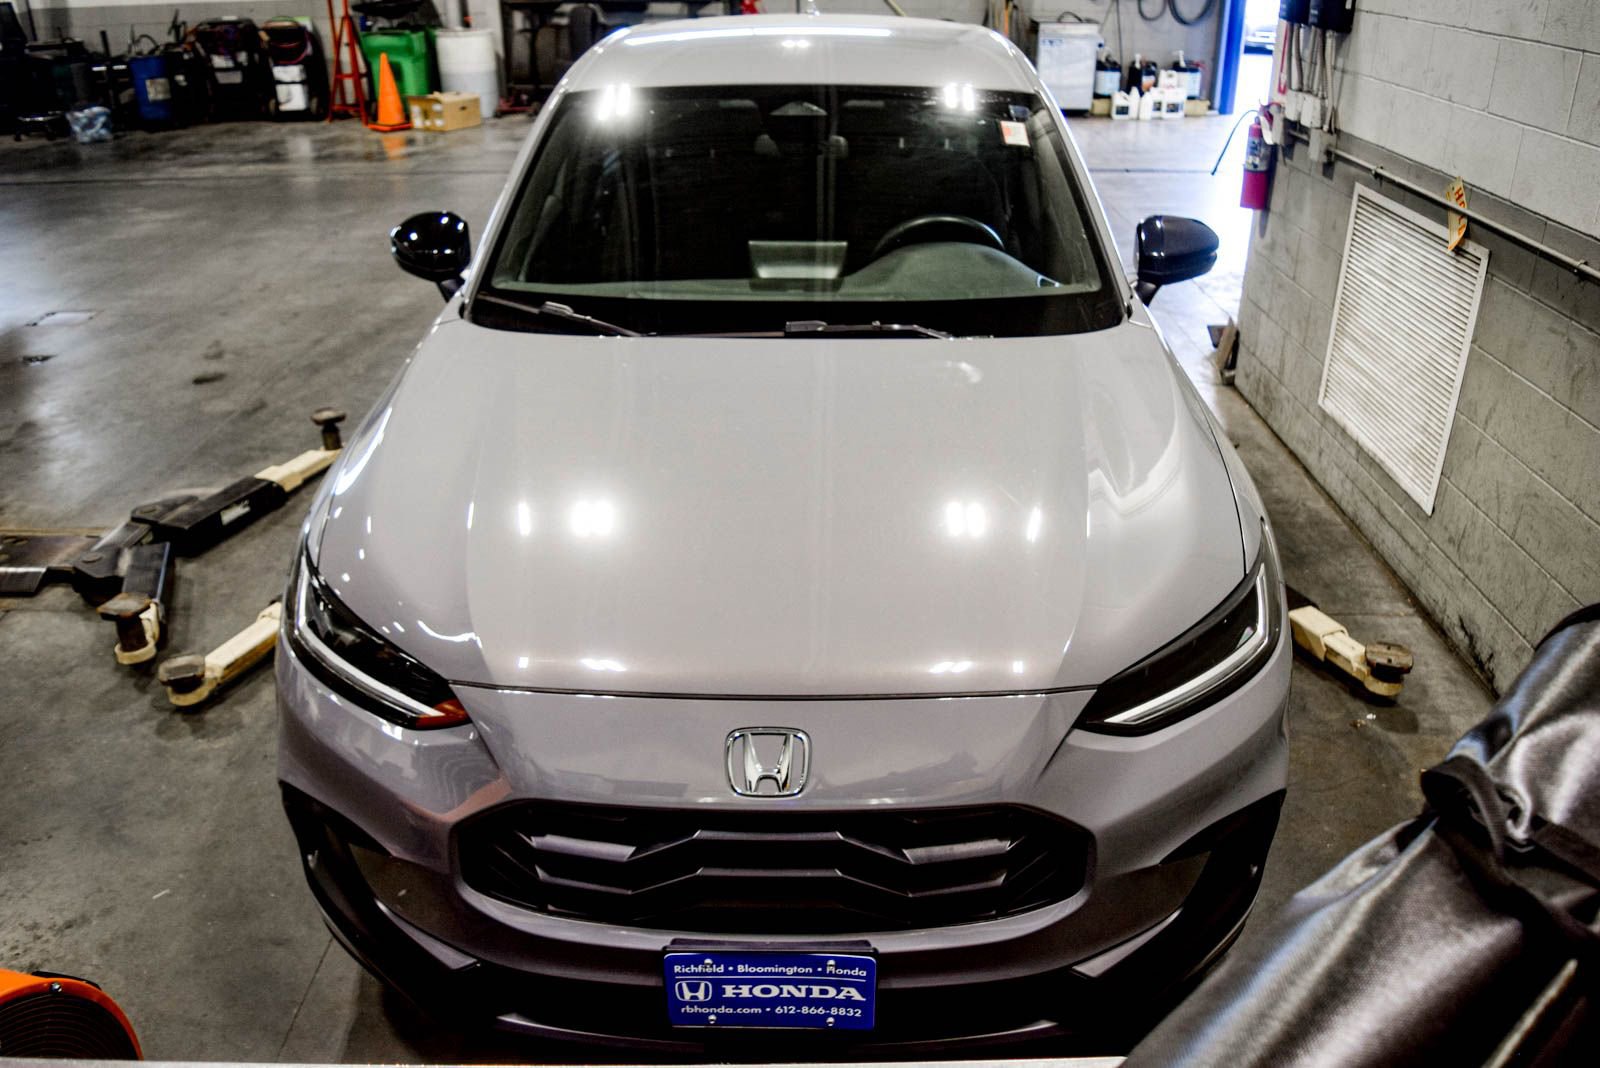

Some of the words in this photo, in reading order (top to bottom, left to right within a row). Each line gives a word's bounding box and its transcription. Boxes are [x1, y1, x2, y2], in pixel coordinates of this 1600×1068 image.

[674, 964, 724, 973] Richfield
[737, 964, 812, 975] Bloomington
[826, 962, 867, 976] Honda
[722, 984, 866, 1001] HONDA
[681, 1005, 762, 1014] rbhonda.com
[775, 1005, 862, 1017] 612-866-8832
